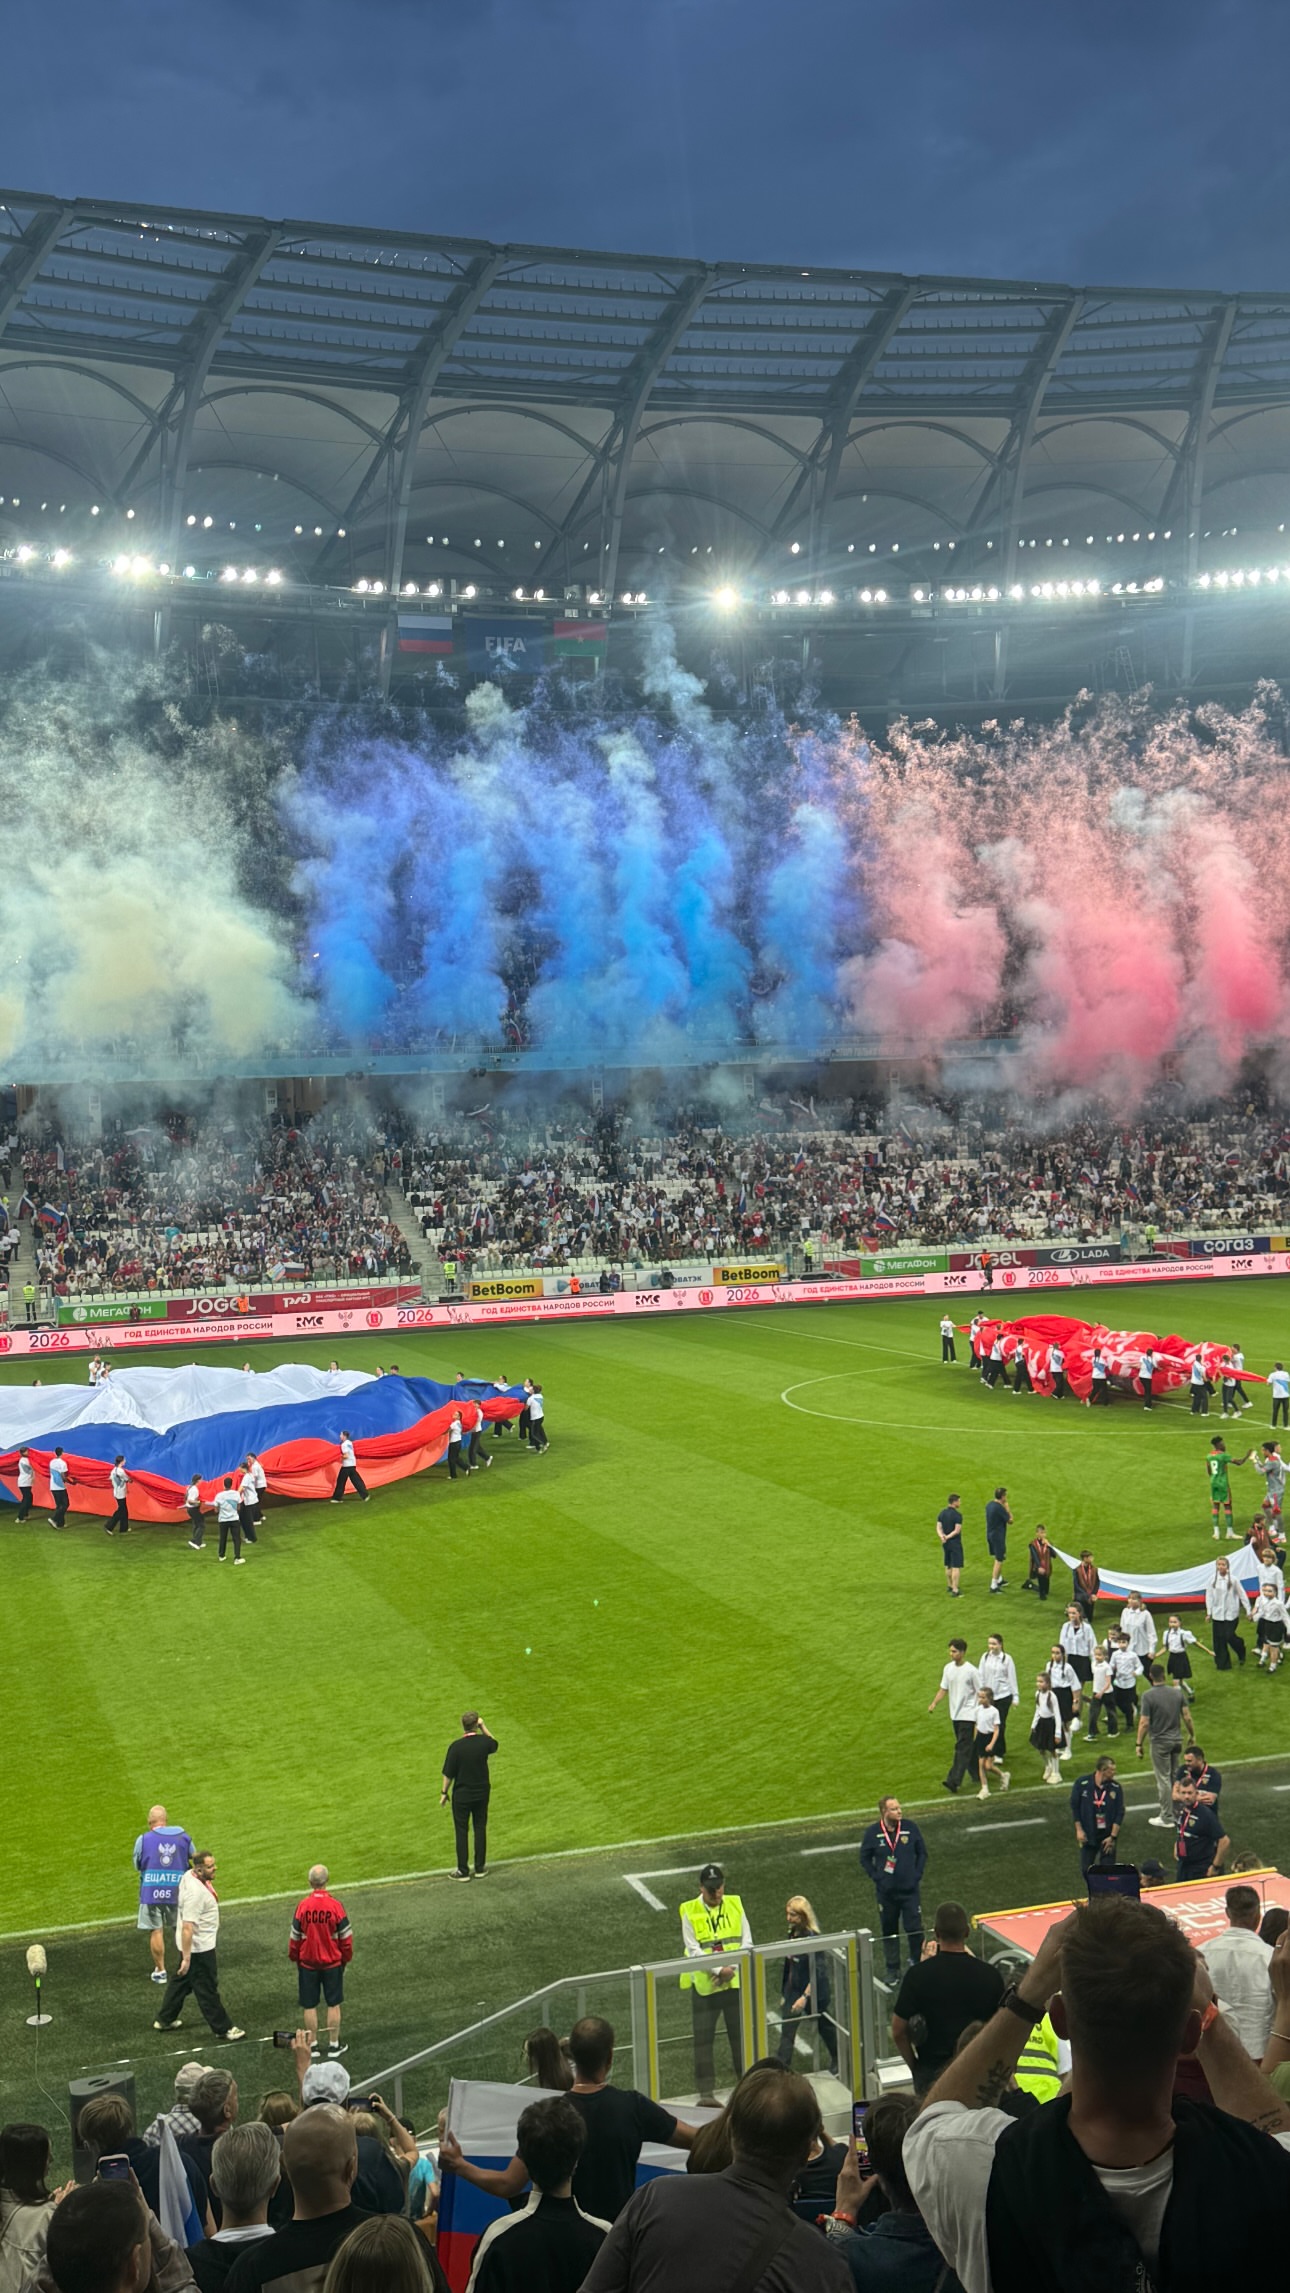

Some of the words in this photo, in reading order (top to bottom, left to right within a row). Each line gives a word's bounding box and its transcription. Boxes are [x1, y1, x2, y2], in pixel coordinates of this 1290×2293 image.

[485, 636, 527, 652] FIFA
[1081, 1249, 1110, 1259] LADA
[887, 1259, 936, 1270] МЕГАФОН
[672, 1275, 702, 1283] ОВАТЭК
[721, 1268, 780, 1281] BetBoom
[1028, 1271, 1059, 1283] 2026
[472, 1282, 534, 1297] BetBoom
[859, 1282, 893, 1290] НАРОДОВ
[726, 1288, 760, 1301] 2026
[481, 1307, 498, 1315] ГОД
[500, 1304, 542, 1314] ЕДИНСТВА
[543, 1302, 580, 1310] НАРОДОВ
[582, 1300, 615, 1308] РОССИИ
[398, 1308, 434, 1323] 2026
[144, 1327, 192, 1337] ЕДИНСТВА
[193, 1324, 235, 1334] НАРОДОВ
[237, 1322, 273, 1330] РОССИИ
[29, 1332, 70, 1348] 2026
[153, 1889, 172, 1899] 065
[305, 1910, 332, 1924] СССР
